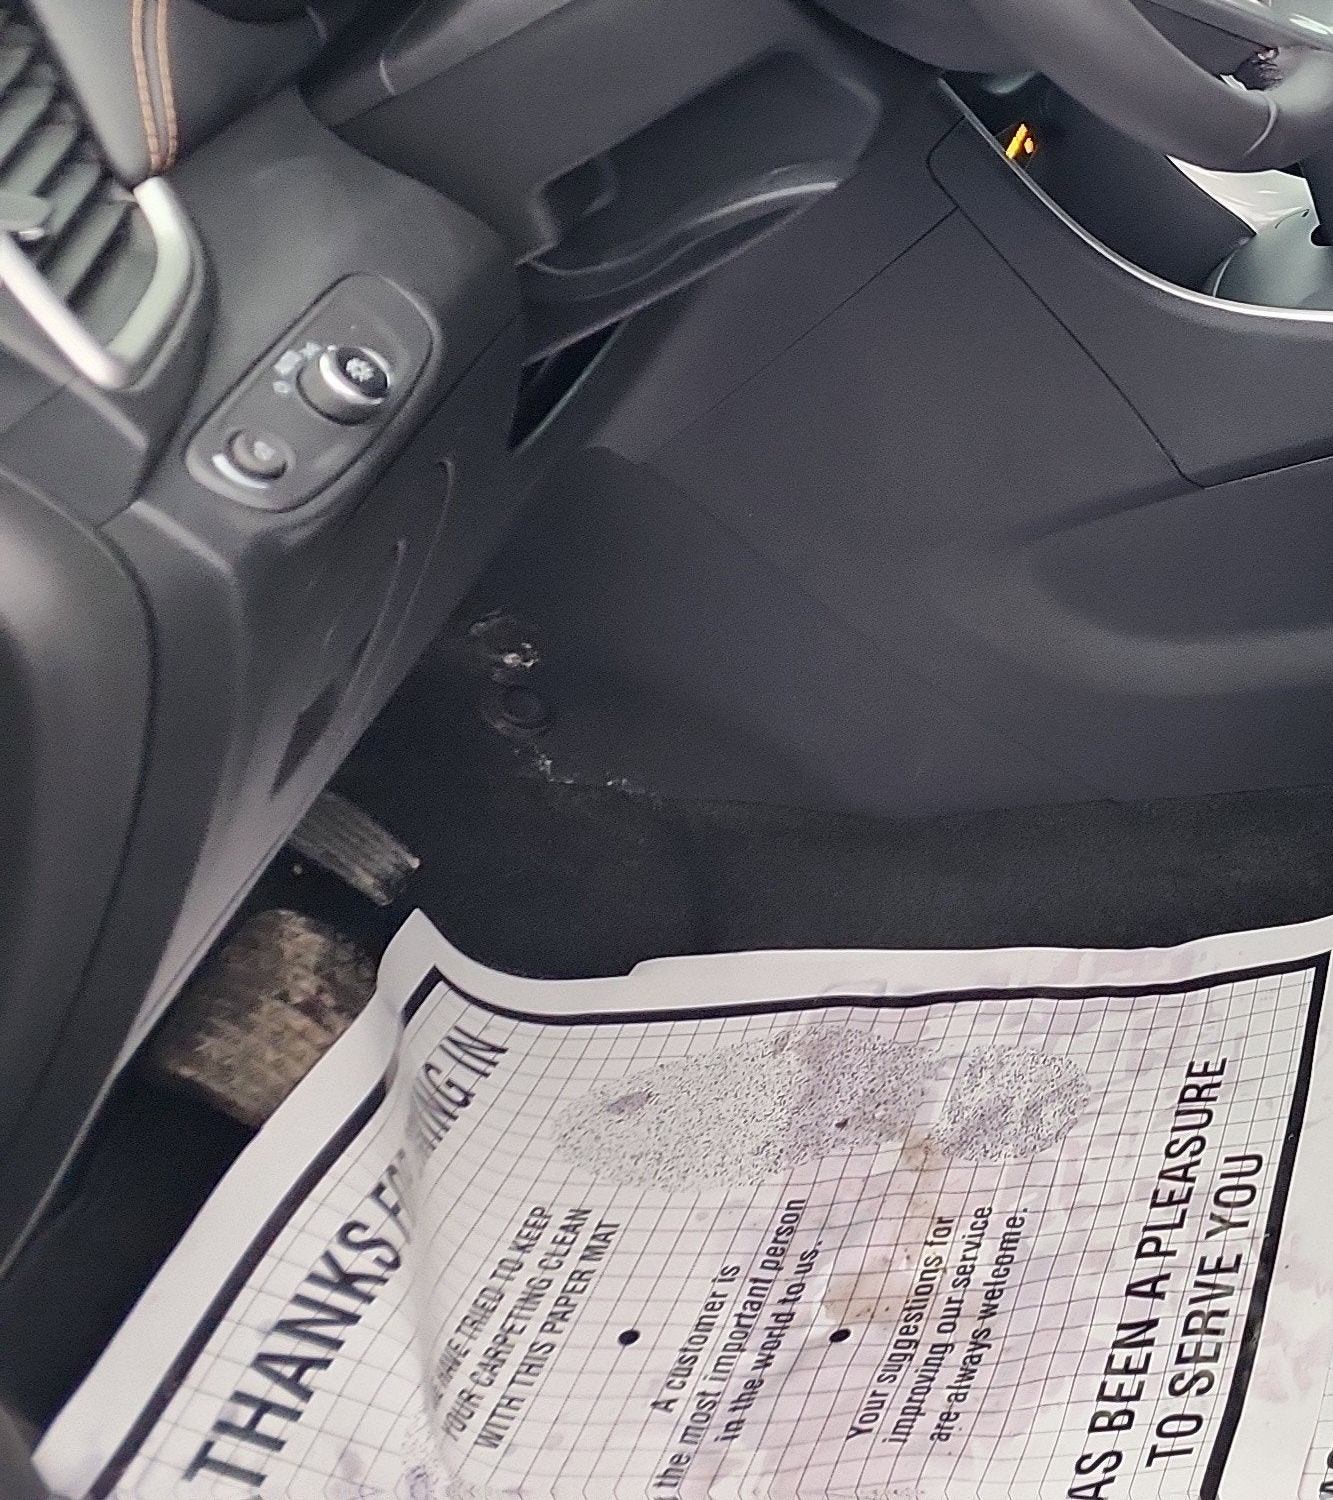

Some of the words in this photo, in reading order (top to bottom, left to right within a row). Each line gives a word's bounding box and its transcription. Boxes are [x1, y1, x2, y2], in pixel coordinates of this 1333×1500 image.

[1135, 1057, 1228, 1259] PLEASURE
[1205, 1154, 1264, 1241] YOU
[181, 1219, 402, 1487] THANKS
[439, 1025, 509, 1078] IN
[455, 1286, 504, 1340] TRIED
[490, 1257, 524, 1281] TO
[508, 1206, 552, 1253] KEEP
[469, 1277, 553, 1388] CARPETING
[538, 1208, 592, 1271] CLEAN
[779, 1282, 805, 1305] to
[794, 1241, 823, 1275] us.
[882, 1342, 954, 1444] improving
[936, 1296, 964, 1334] our
[952, 1206, 992, 1289] service
[929, 1411, 960, 1442] are
[946, 1327, 992, 1403] always
[977, 1208, 1028, 1321] welcome.
[1125, 1272, 1171, 1300] A
[1168, 1253, 1243, 1397] SERVE
[474, 1395, 525, 1449] WITH
[509, 1341, 555, 1387] THIS
[540, 1268, 596, 1335] PAPER
[580, 1220, 620, 1261] MAT
[650, 1398, 679, 1413] A
[666, 1291, 728, 1390] customer
[712, 1265, 741, 1283] is
[653, 1451, 691, 1488] the
[679, 1391, 721, 1445] most
[703, 1277, 773, 1382] important
[760, 1199, 806, 1271] person
[728, 1378, 764, 1413] the
[752, 1311, 796, 1371] world
[846, 1390, 890, 1440] Your
[877, 1254, 943, 1384] suggestions
[925, 1215, 955, 1247] for
[1088, 1318, 1159, 1434] BEEN
[714, 1418, 746, 1442] in
[1145, 1414, 1203, 1468] TO
